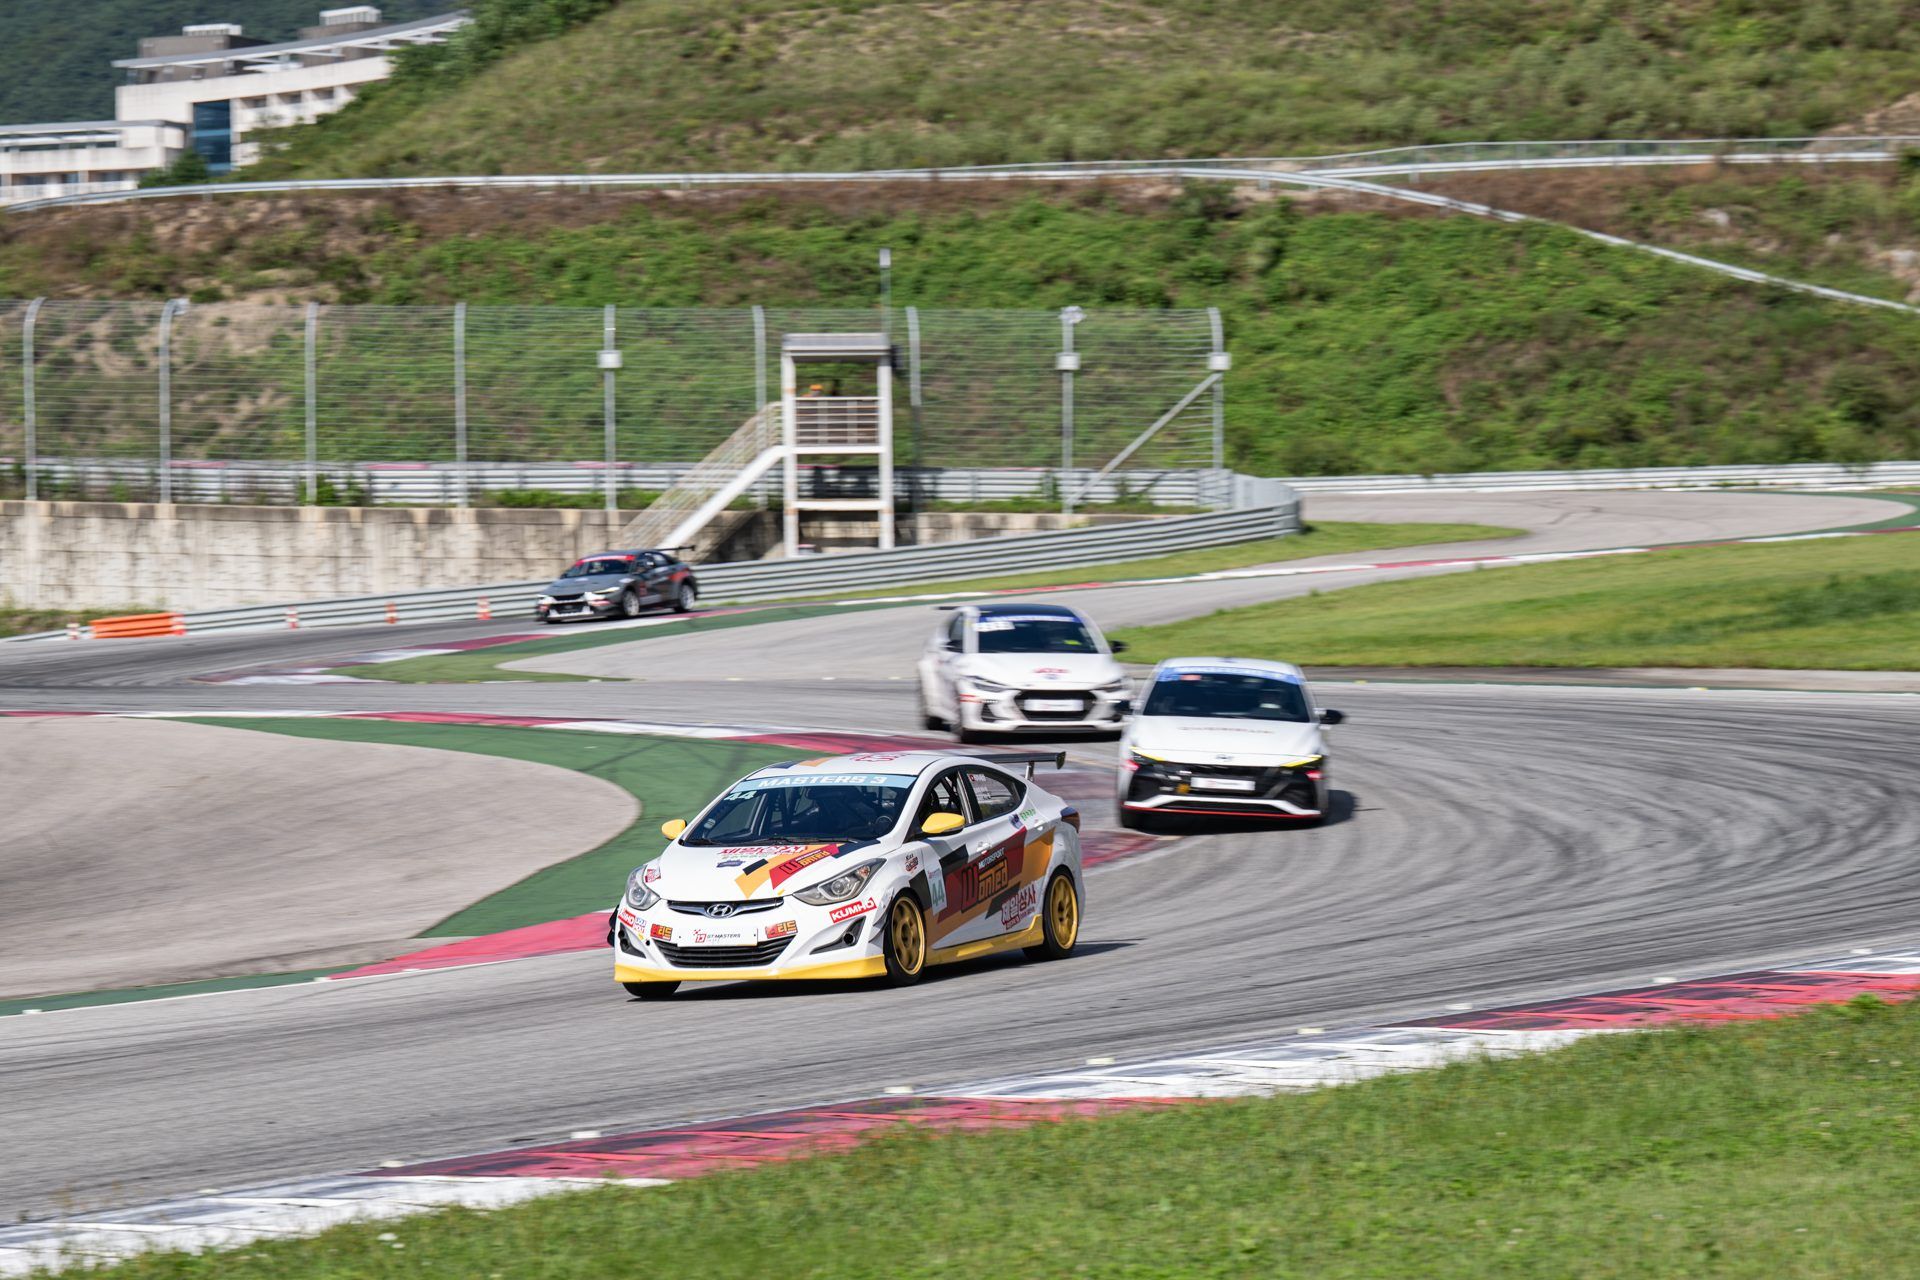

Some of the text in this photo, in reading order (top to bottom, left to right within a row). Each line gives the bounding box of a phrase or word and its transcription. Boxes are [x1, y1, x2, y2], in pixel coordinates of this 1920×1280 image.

[758, 775, 887, 787] MASTERS 3
[724, 790, 757, 801] 44
[932, 880, 944, 906] 44
[831, 899, 876, 920] KUMHO
